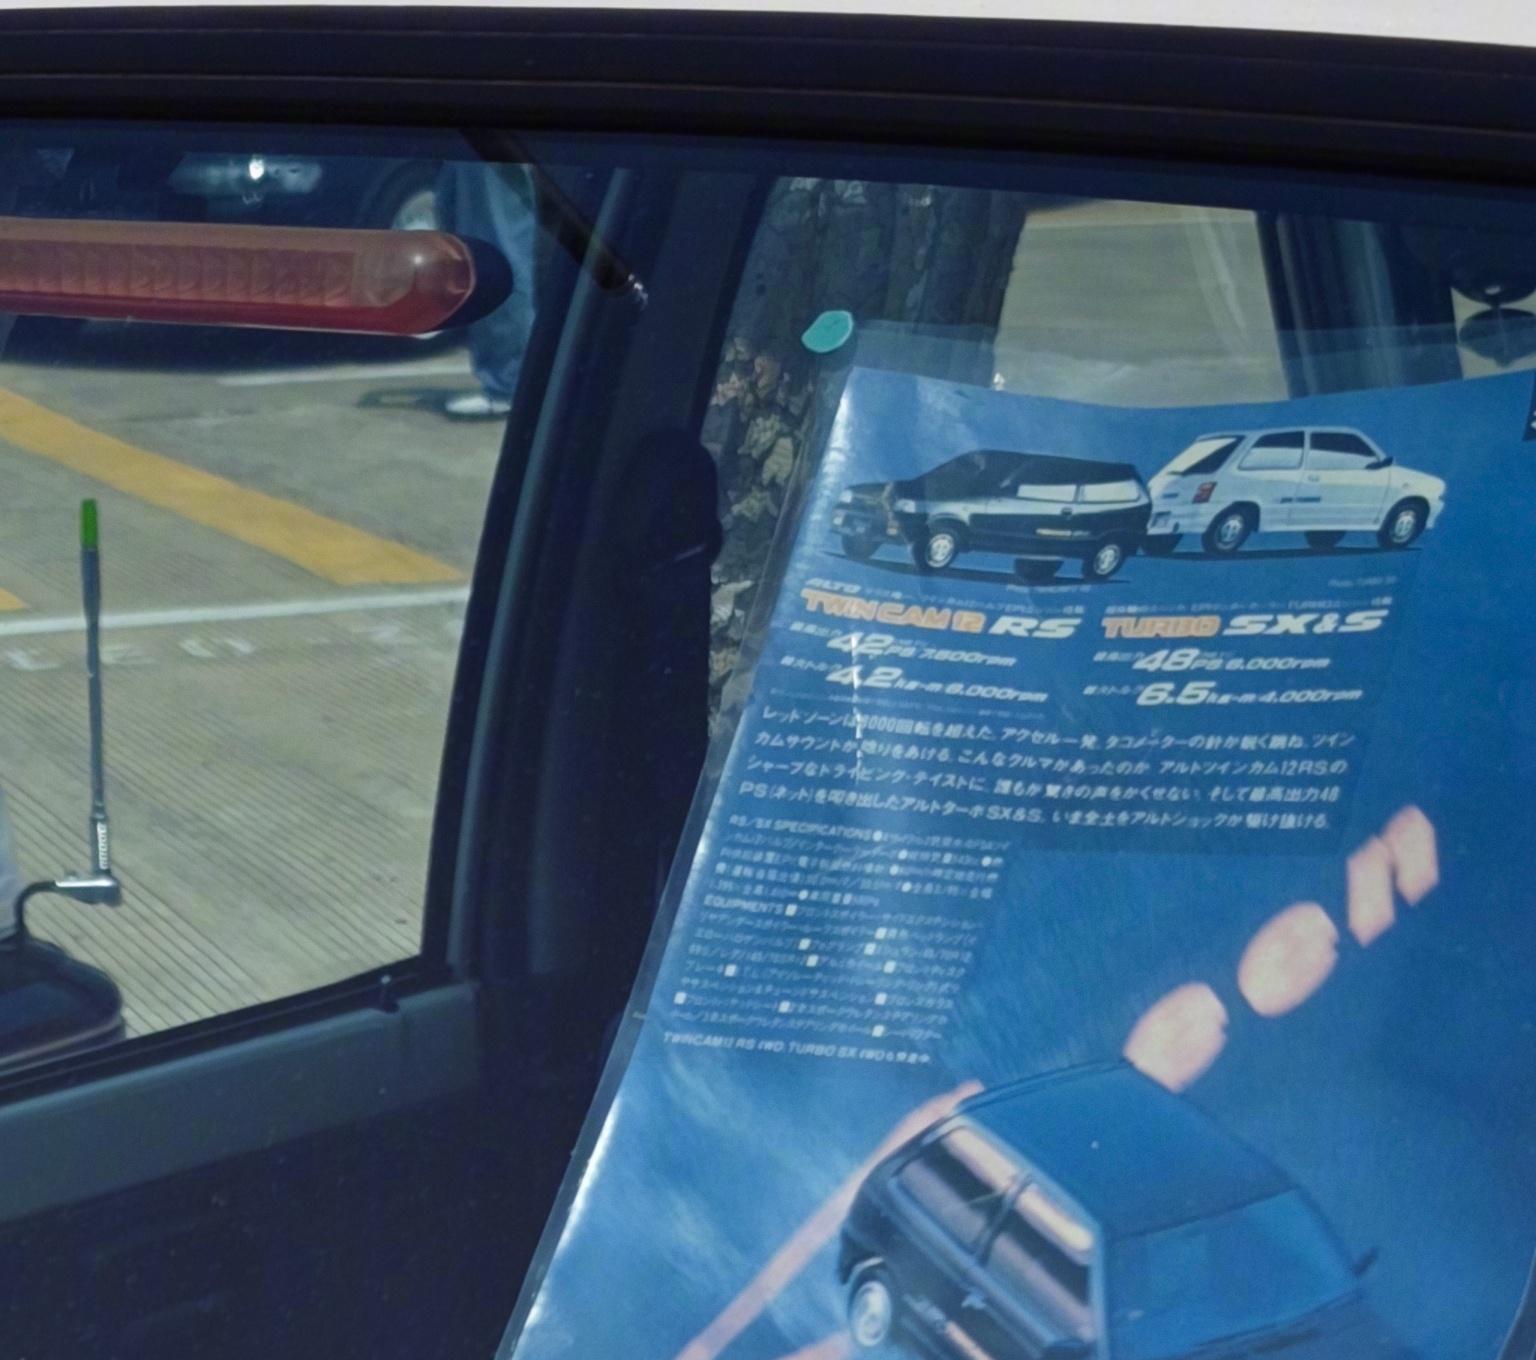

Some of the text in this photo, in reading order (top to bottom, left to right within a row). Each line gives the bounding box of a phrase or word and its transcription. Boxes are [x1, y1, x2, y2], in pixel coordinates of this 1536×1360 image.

[988, 614, 1083, 639] RS
[1101, 609, 1390, 639] TURBO SX&S
